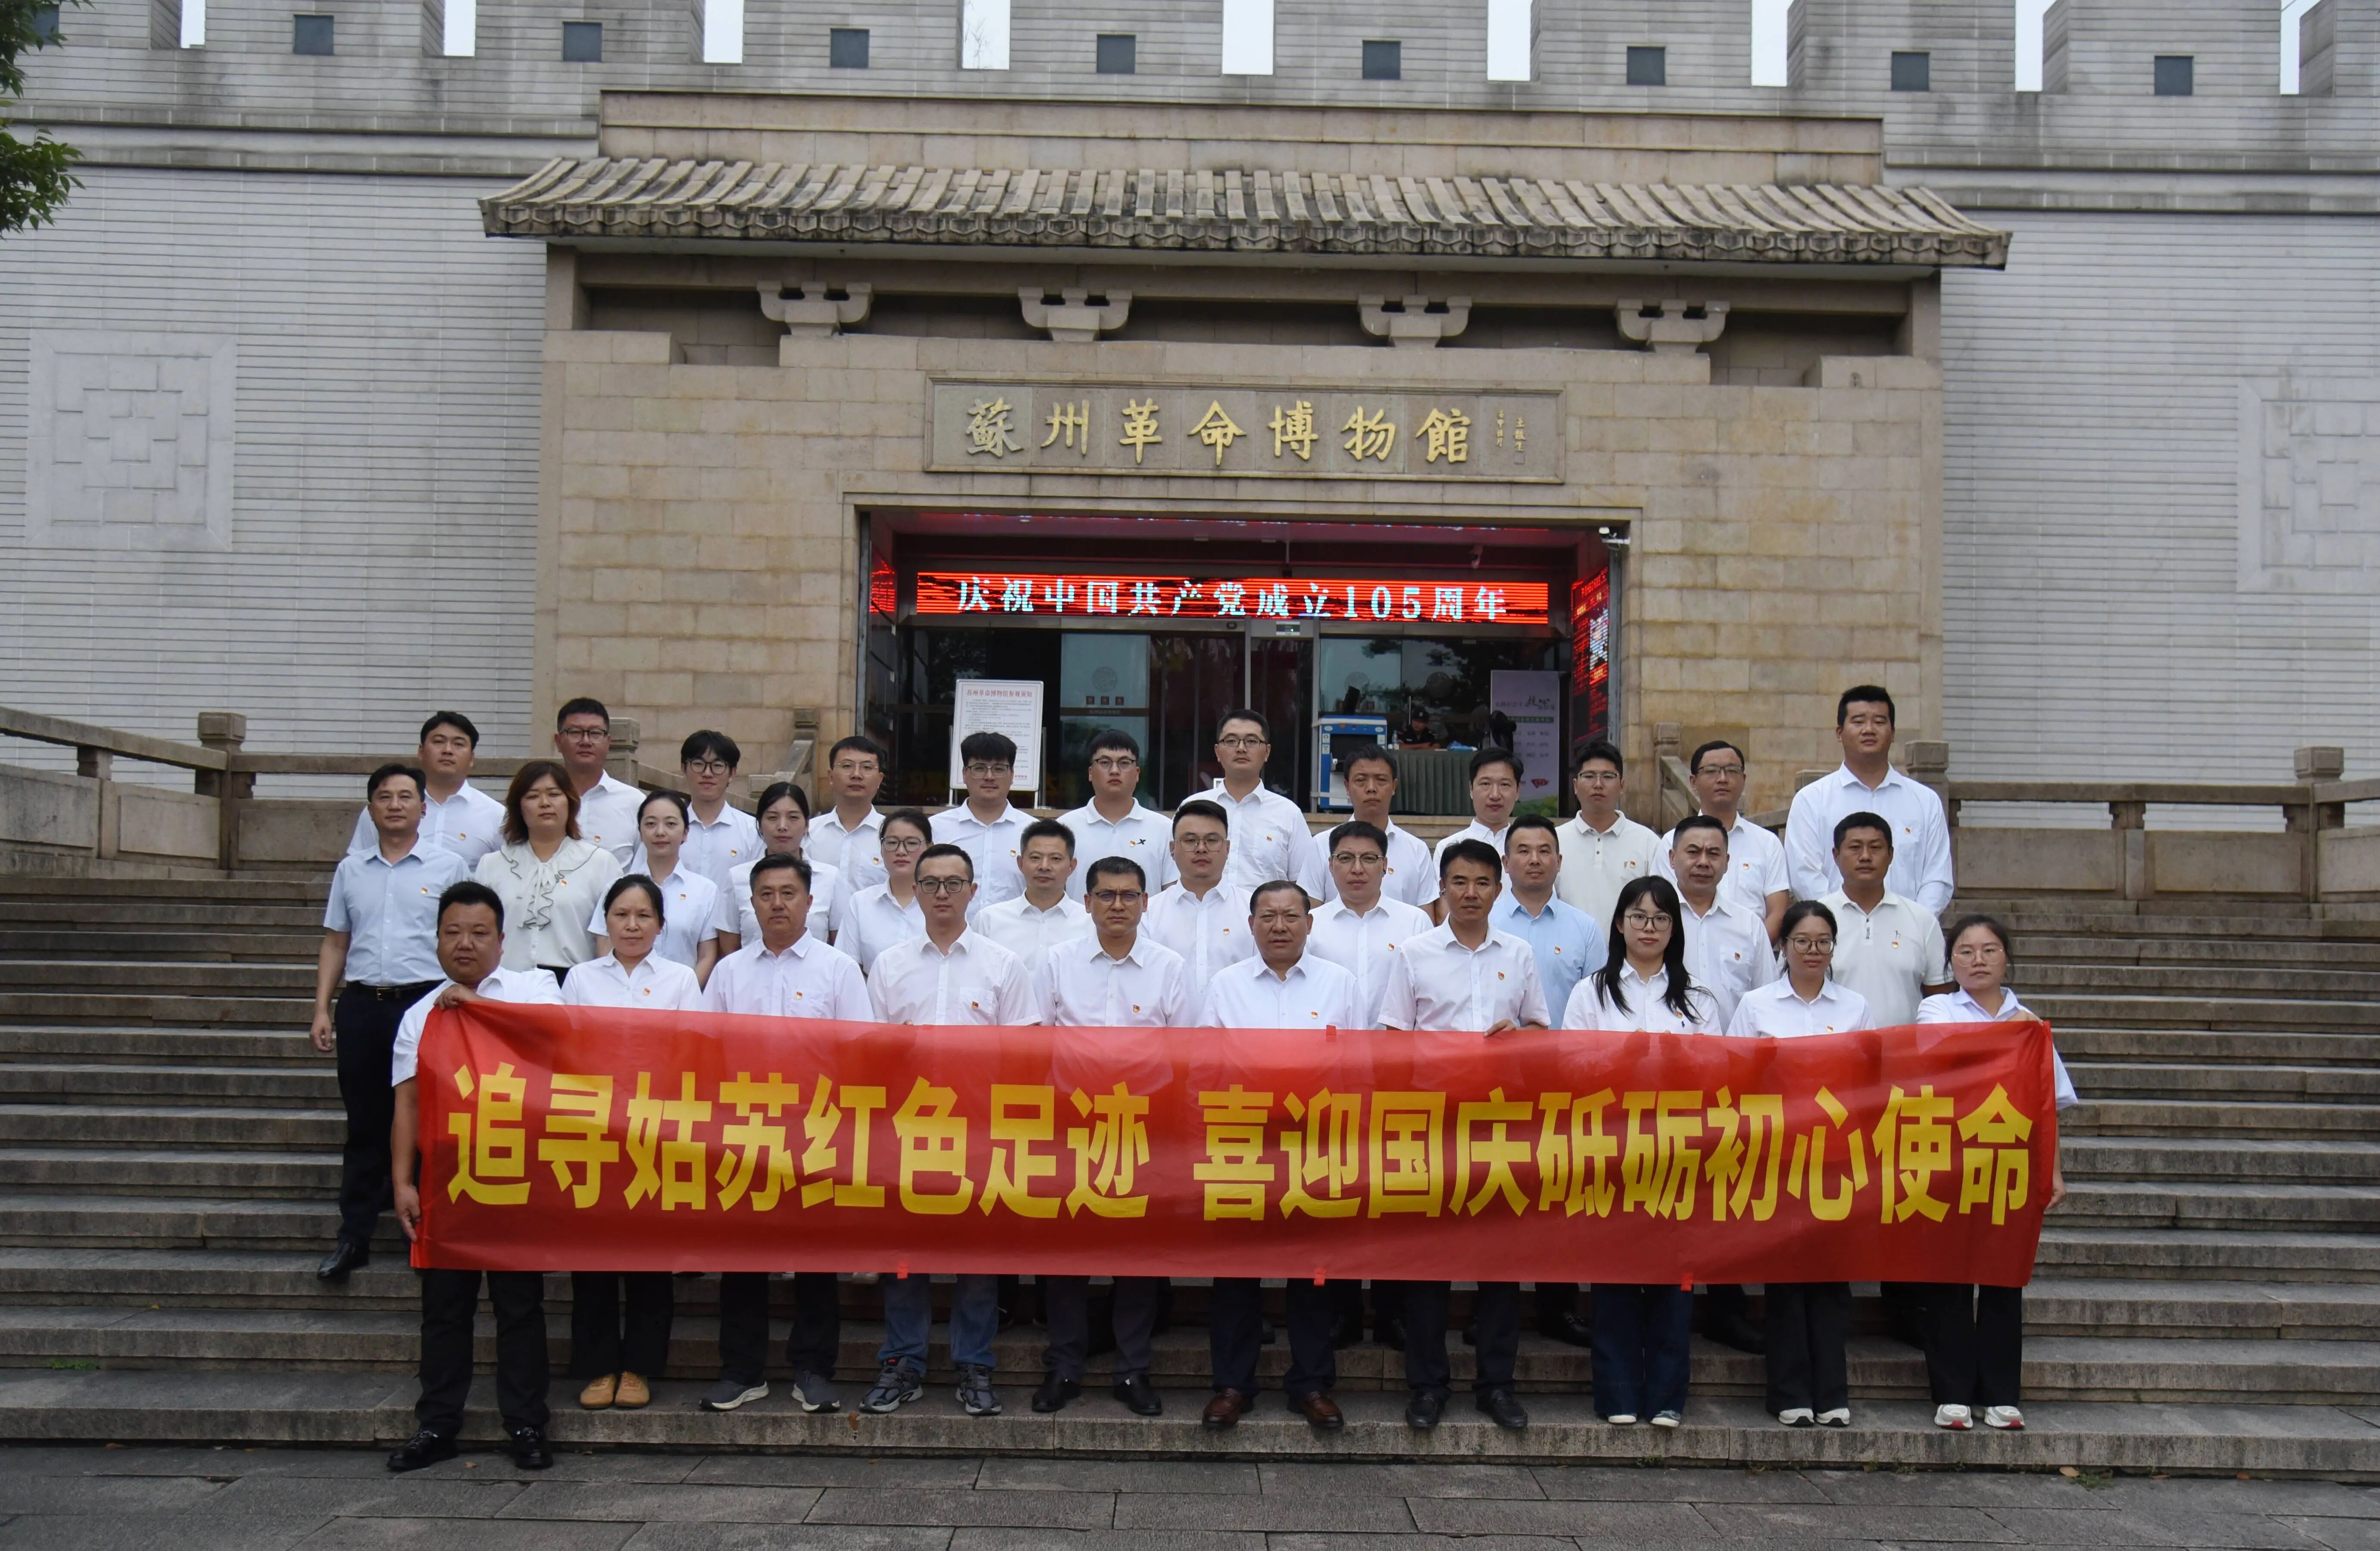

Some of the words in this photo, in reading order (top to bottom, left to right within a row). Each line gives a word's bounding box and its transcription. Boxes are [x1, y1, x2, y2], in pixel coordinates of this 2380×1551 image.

[965, 397, 1471, 466] 蘇州革命博物館
[958, 576, 1506, 620] 庆祝中国共产党成立105周年
[447, 1062, 1149, 1218] 追寻姑苏红色足迹
[1193, 1082, 2033, 1226] 喜迎国庆砥砺初心使命
